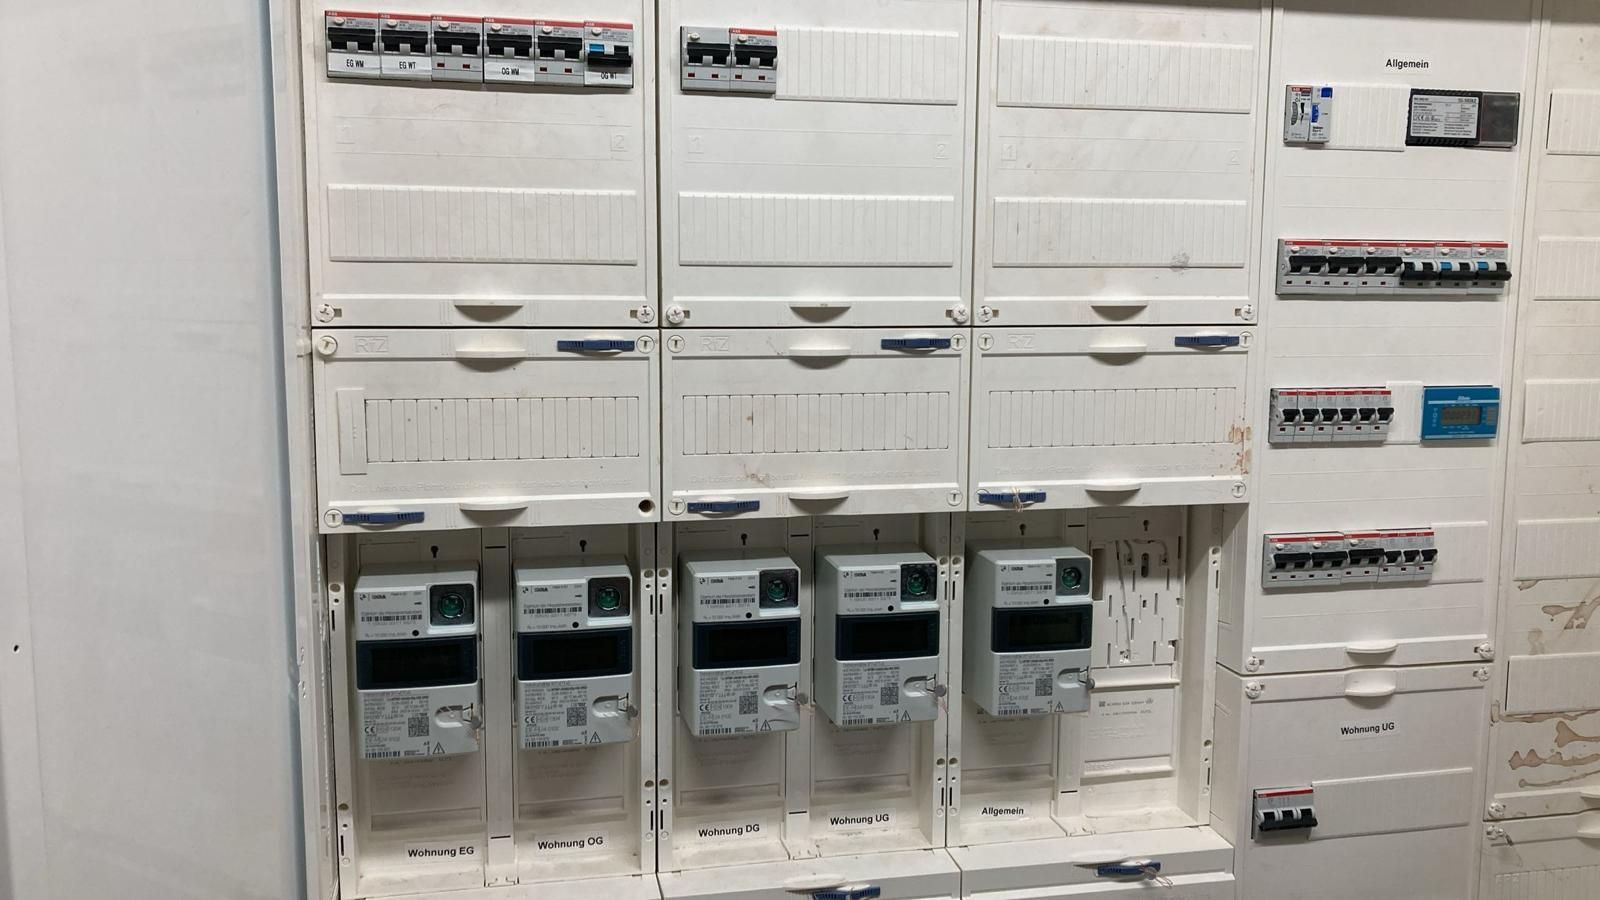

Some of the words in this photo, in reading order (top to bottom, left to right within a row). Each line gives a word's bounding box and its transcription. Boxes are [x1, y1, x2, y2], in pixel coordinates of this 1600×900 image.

[346, 59, 354, 68] EG
[355, 60, 364, 68] WM
[399, 61, 407, 70] EG
[408, 62, 416, 70] WT
[1385, 58, 1429, 69] Allgemein
[501, 67, 509, 75] OG
[1340, 725, 1380, 735] Wohnung
[1382, 722, 1395, 731] UG
[981, 807, 1024, 817] Allgemein
[830, 816, 873, 826] Wohnung
[875, 813, 889, 823] UG
[698, 826, 743, 837] Wohnung
[745, 823, 760, 833] DG
[537, 839, 585, 850] Wohnung
[587, 836, 603, 845] OG
[407, 849, 457, 858] Wohnung
[459, 846, 475, 855] EG
